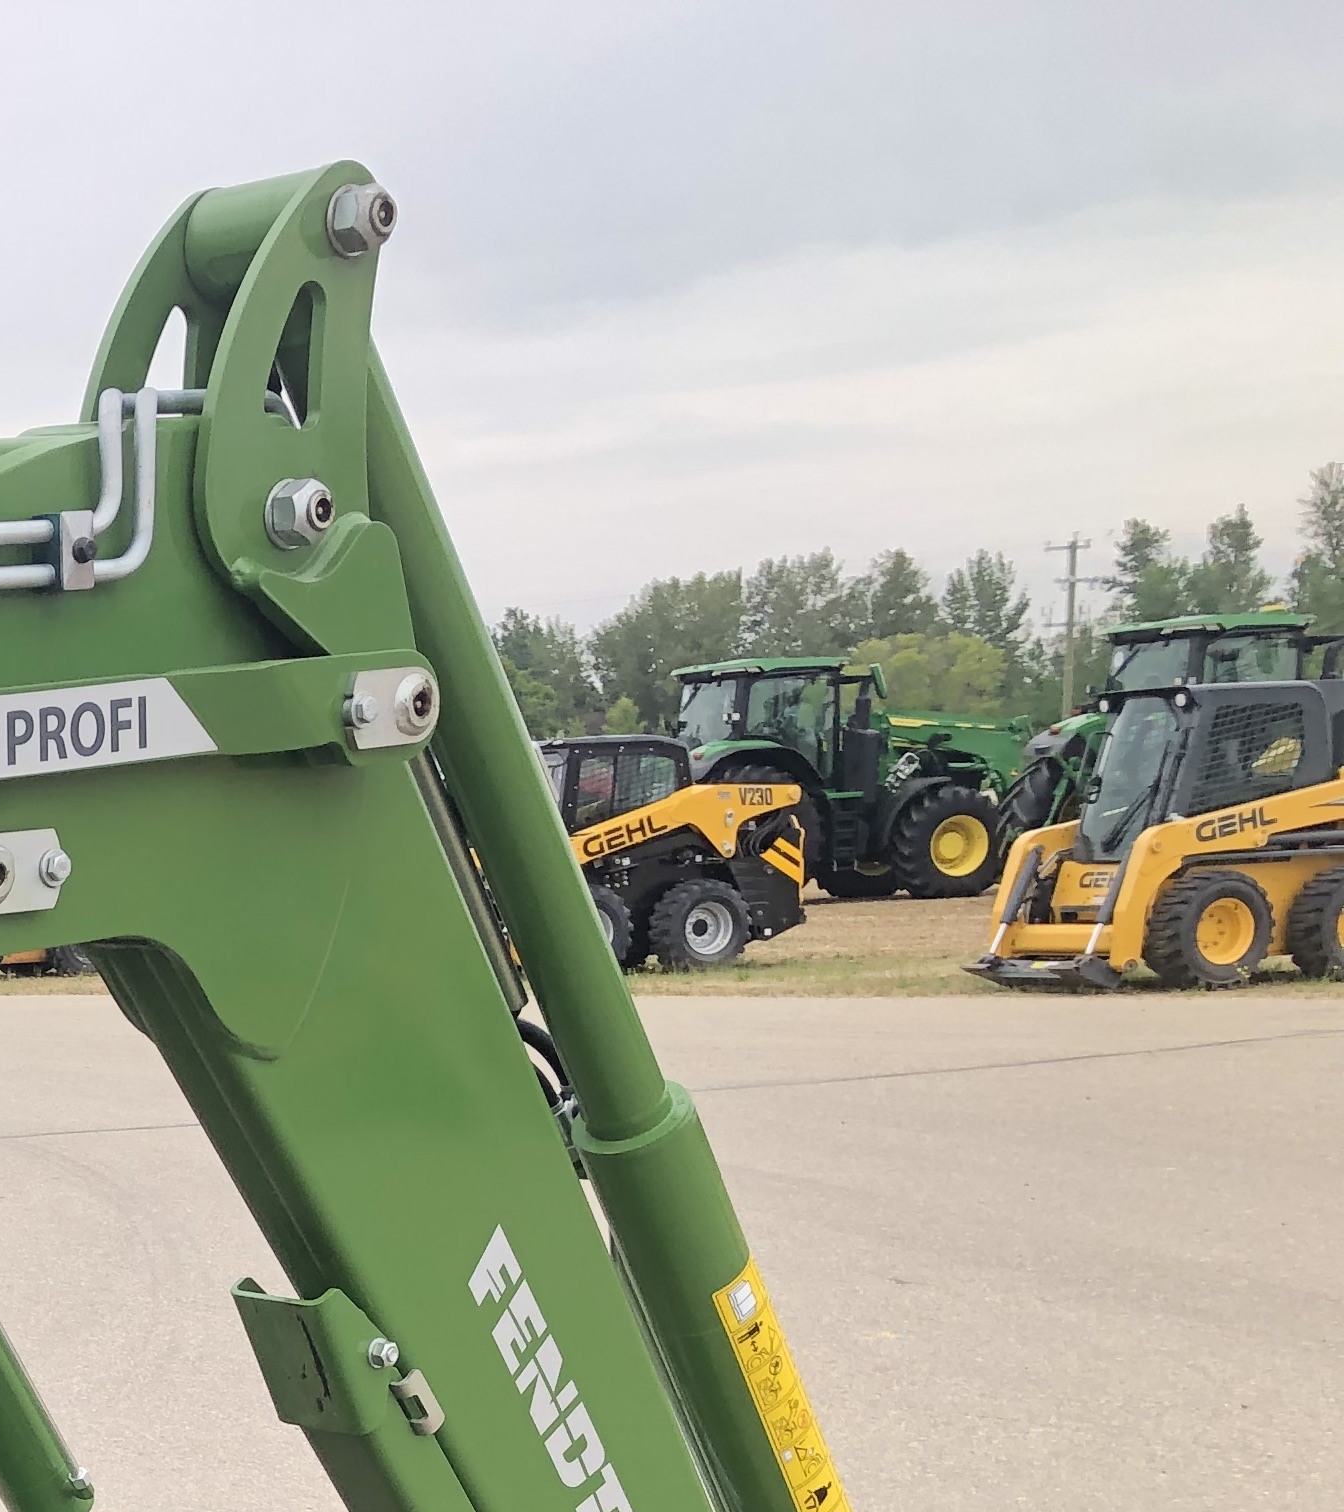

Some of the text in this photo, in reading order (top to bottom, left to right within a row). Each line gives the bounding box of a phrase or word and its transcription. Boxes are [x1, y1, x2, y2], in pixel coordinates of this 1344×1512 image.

[6, 695, 148, 766] PROFI
[738, 787, 774, 806] V230
[582, 815, 668, 858] GEHL
[1196, 806, 1278, 842] GEHL
[1079, 871, 1115, 888] GE
